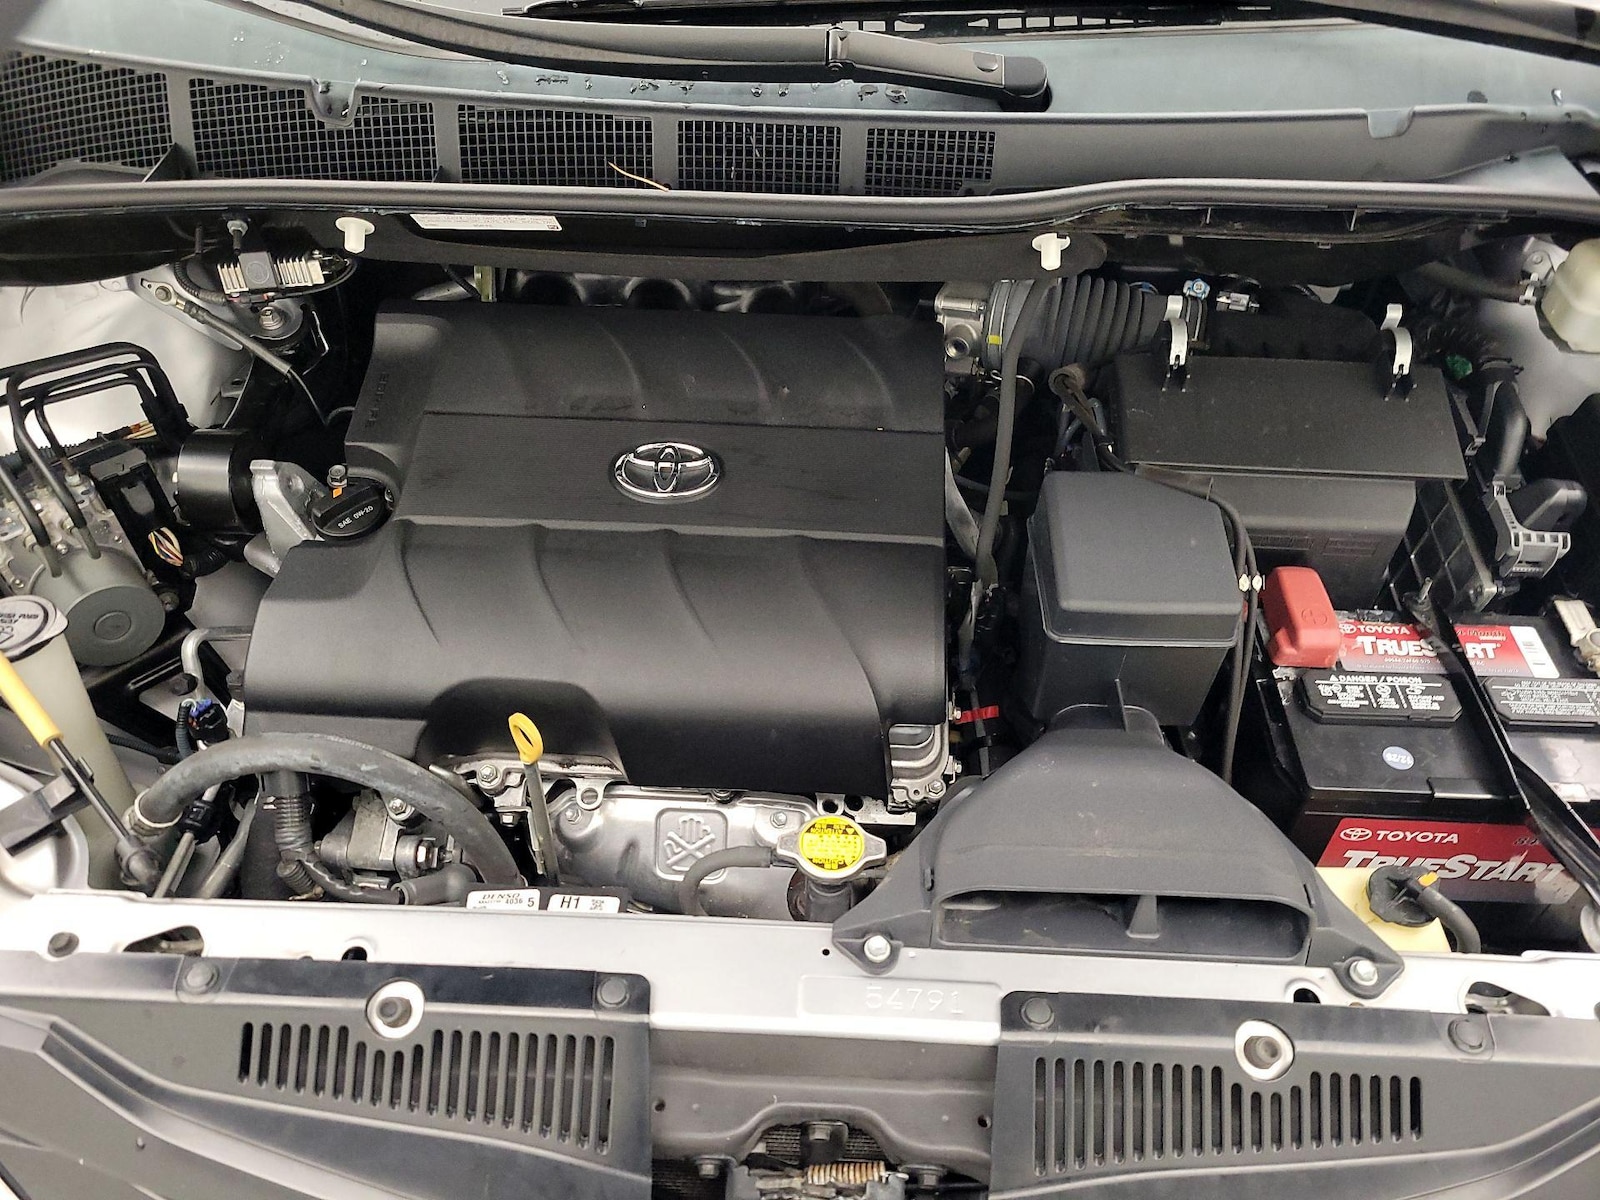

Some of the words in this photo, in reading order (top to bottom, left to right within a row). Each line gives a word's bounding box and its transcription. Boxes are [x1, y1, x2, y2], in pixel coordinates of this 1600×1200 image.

[337, 516, 353, 529] SAE
[353, 505, 374, 520] 0W-20
[1357, 625, 1411, 635] TOYOTA
[1339, 674, 1379, 683] DANGER
[1386, 676, 1423, 684] POISON
[1376, 830, 1459, 844] TOYOTA
[527, 897, 535, 908] 5
[560, 896, 581, 909] H1
[865, 985, 965, 1015] 54791
